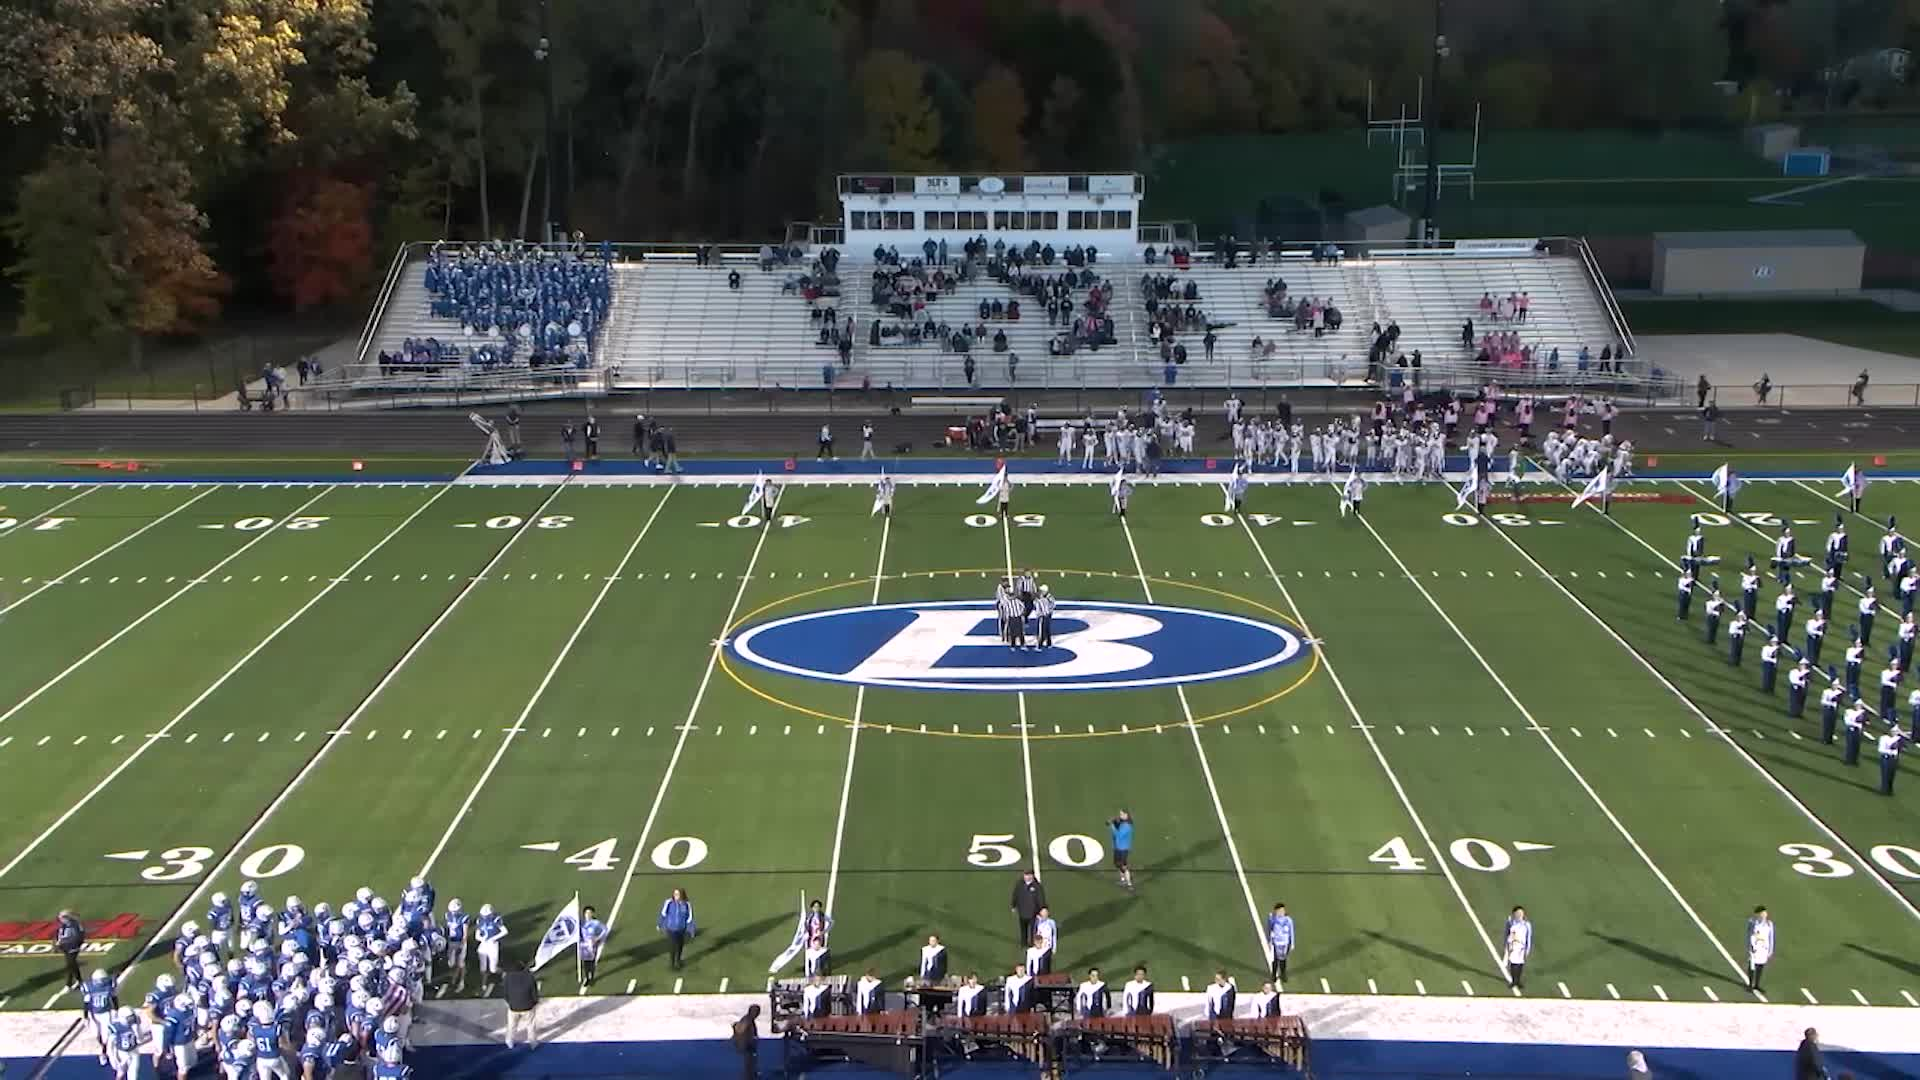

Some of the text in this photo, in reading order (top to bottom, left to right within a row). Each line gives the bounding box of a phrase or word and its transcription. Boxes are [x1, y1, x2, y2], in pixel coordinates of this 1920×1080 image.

[964, 513, 1046, 527] 50
[1200, 513, 1283, 526] 40
[846, 608, 1163, 678] B
[141, 844, 305, 880] 30
[564, 836, 709, 871] 40
[967, 834, 1105, 867] 50
[1368, 836, 1511, 872] 40
[256, 1037, 272, 1052] 61
